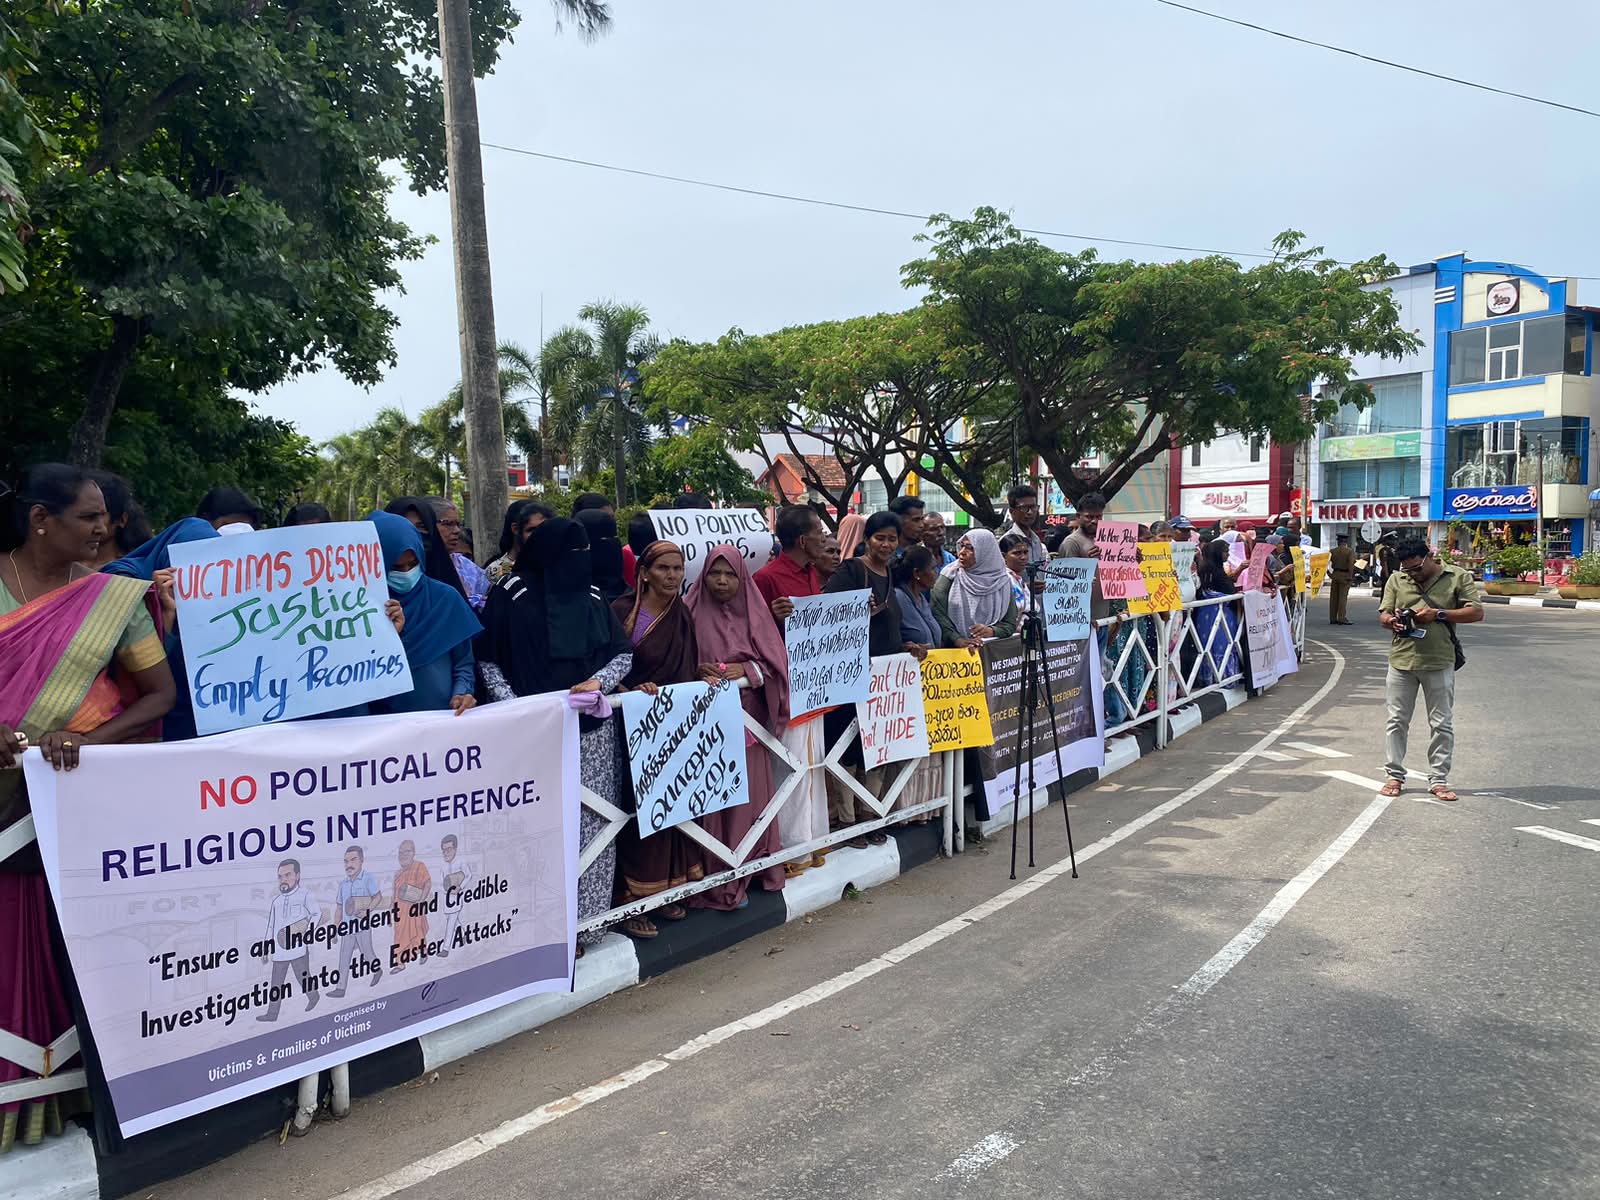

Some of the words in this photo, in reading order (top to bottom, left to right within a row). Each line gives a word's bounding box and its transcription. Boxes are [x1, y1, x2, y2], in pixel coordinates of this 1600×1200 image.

[657, 515, 689, 539] NO
[173, 551, 292, 600] VICTIMS
[303, 541, 382, 588] DESERVE
[1142, 548, 1172, 568] ommunity
[297, 607, 378, 645] NOT
[194, 655, 291, 723] Empty
[869, 661, 891, 694] ant
[896, 660, 916, 689] the
[866, 692, 905, 721] TRUTH
[885, 717, 916, 744] HIDE
[200, 775, 257, 810] NO
[270, 751, 437, 800] POLITICAL
[444, 745, 482, 771] OR
[101, 820, 316, 882] RELIGIOUS
[326, 779, 540, 846] INTERFERENCE.
[148, 942, 240, 981] “Ensure
[250, 936, 276, 958] an
[285, 903, 400, 961] Independent
[409, 895, 438, 917] and
[445, 875, 509, 911] Credible
[140, 983, 292, 1038] Investigation
[301, 968, 341, 994] into
[349, 953, 382, 978] the
[390, 938, 445, 968] Easter
[451, 909, 519, 949] Attacks”
[334, 1004, 376, 1023] Organised
[376, 1000, 387, 1013] by
[208, 1057, 253, 1082] Victims
[257, 1053, 267, 1066] &
[271, 1037, 317, 1062] Families
[320, 1031, 331, 1045] of
[334, 1020, 372, 1040] Victims
